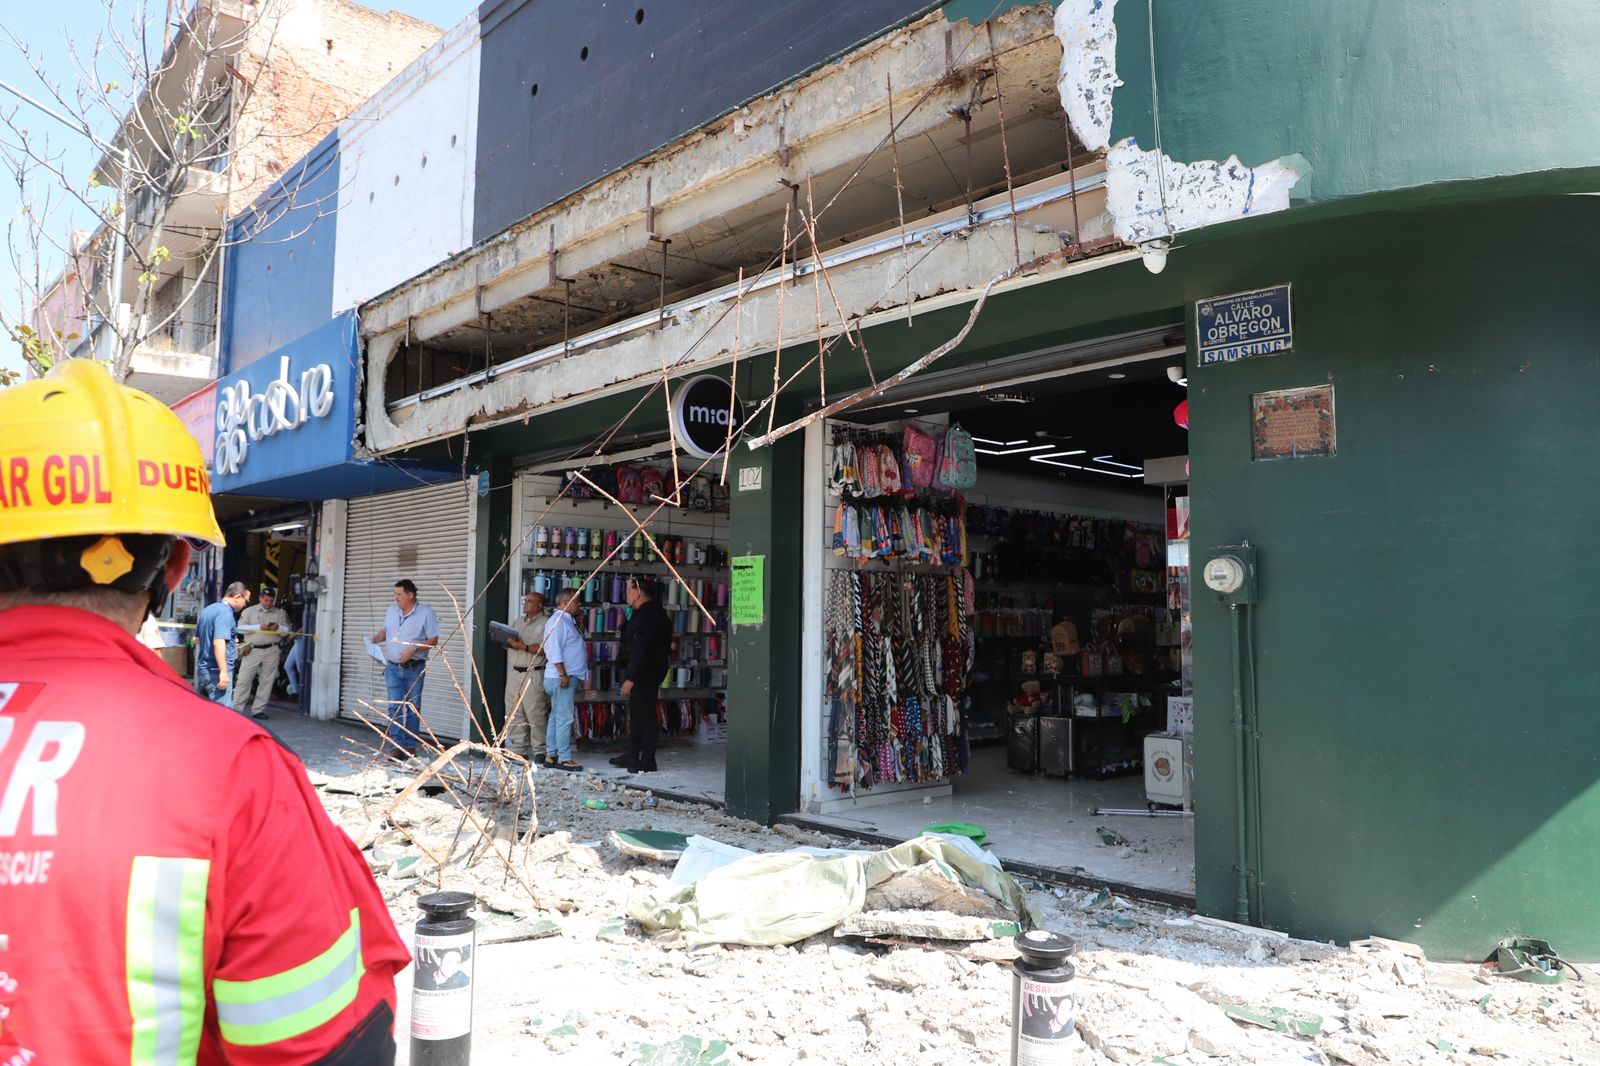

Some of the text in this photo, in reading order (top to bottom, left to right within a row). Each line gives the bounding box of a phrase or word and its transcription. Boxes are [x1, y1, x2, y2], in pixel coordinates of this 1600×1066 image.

[1214, 304, 1273, 326] ALVARO
[1231, 300, 1254, 311] CALLE
[1208, 316, 1281, 340] OBREGON
[1207, 341, 1282, 363] SAMSUNG
[43, 454, 112, 506] GDL
[740, 467, 760, 487] 102
